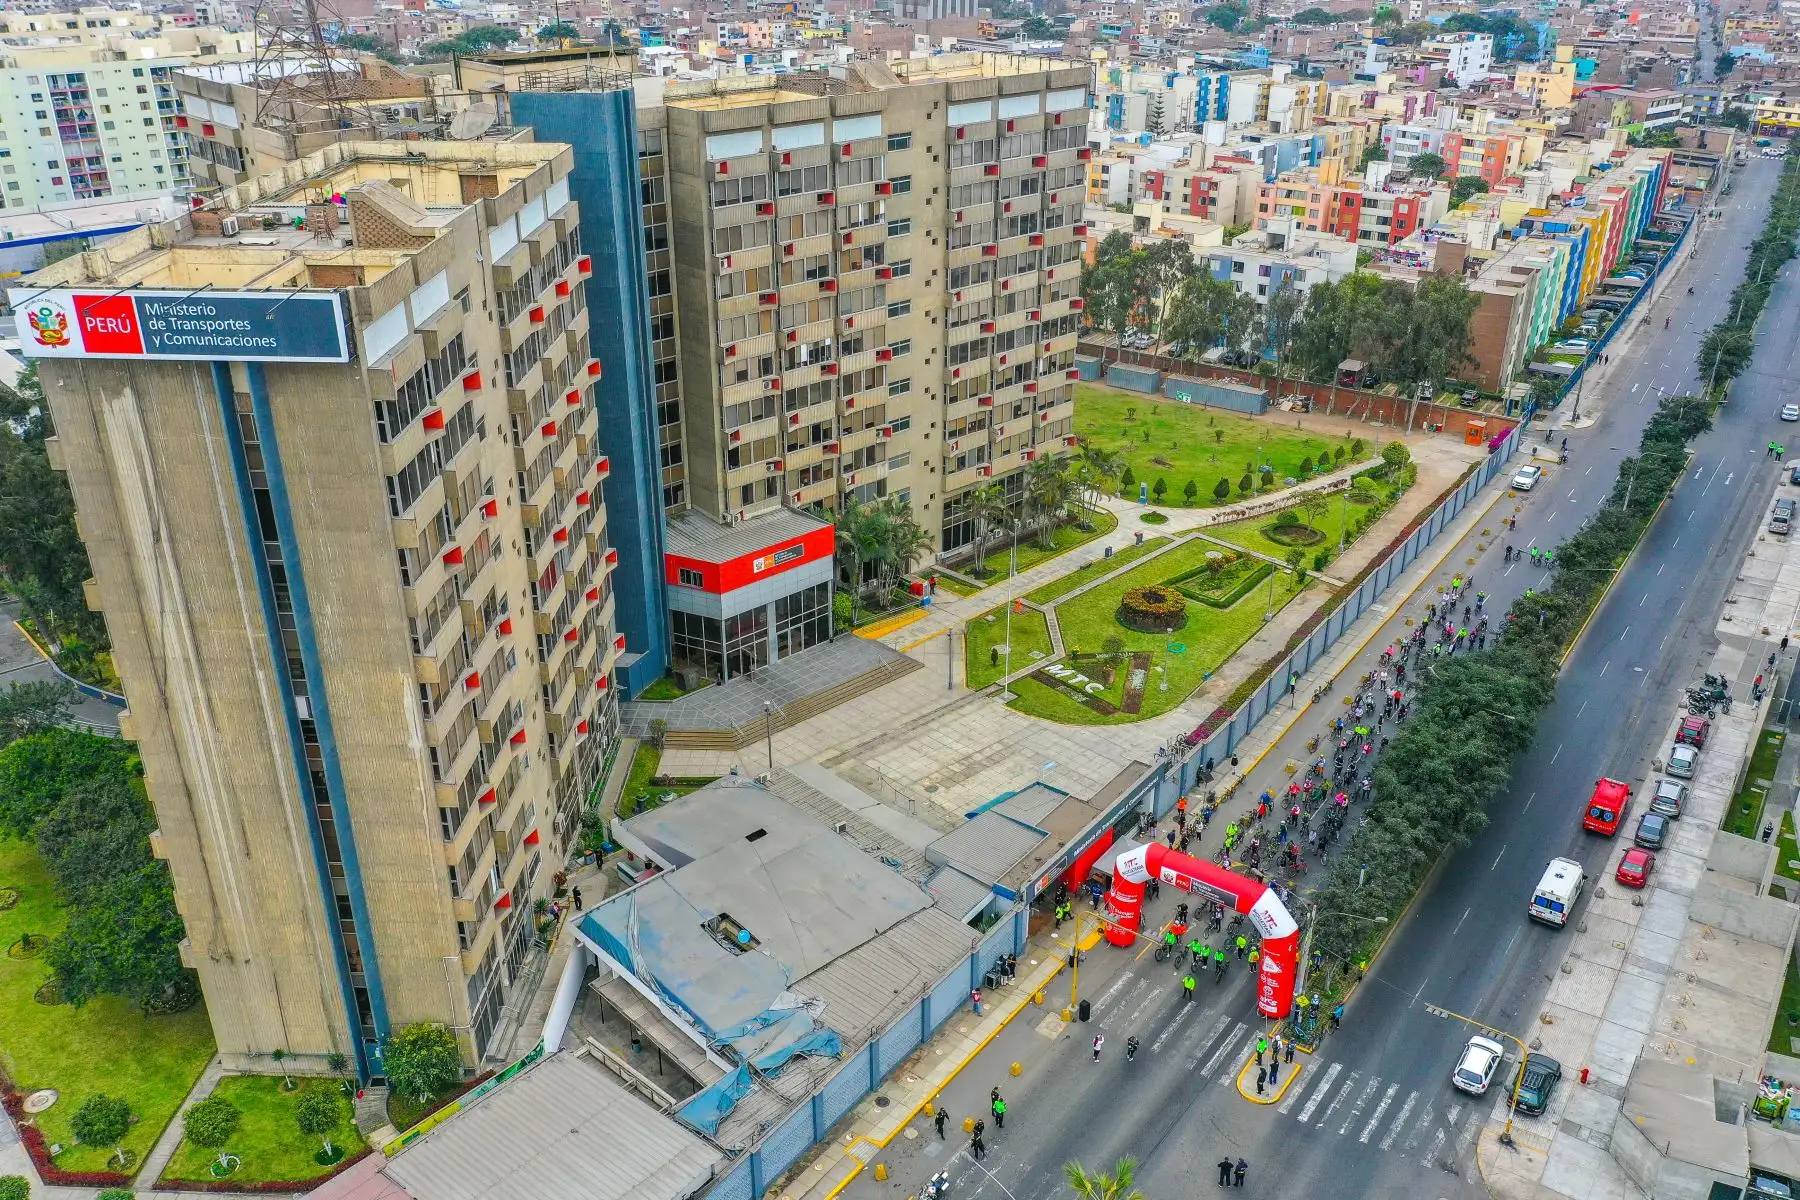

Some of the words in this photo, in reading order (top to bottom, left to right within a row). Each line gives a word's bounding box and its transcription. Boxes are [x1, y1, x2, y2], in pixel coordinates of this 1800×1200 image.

[145, 302, 216, 315] Ministerio
[84, 313, 131, 333] PERÚ
[149, 317, 167, 330] de
[169, 316, 251, 333] Transportes
[152, 334, 161, 347] y
[163, 332, 277, 347] Comunicaciones
[1044, 664, 1104, 693] MTC
